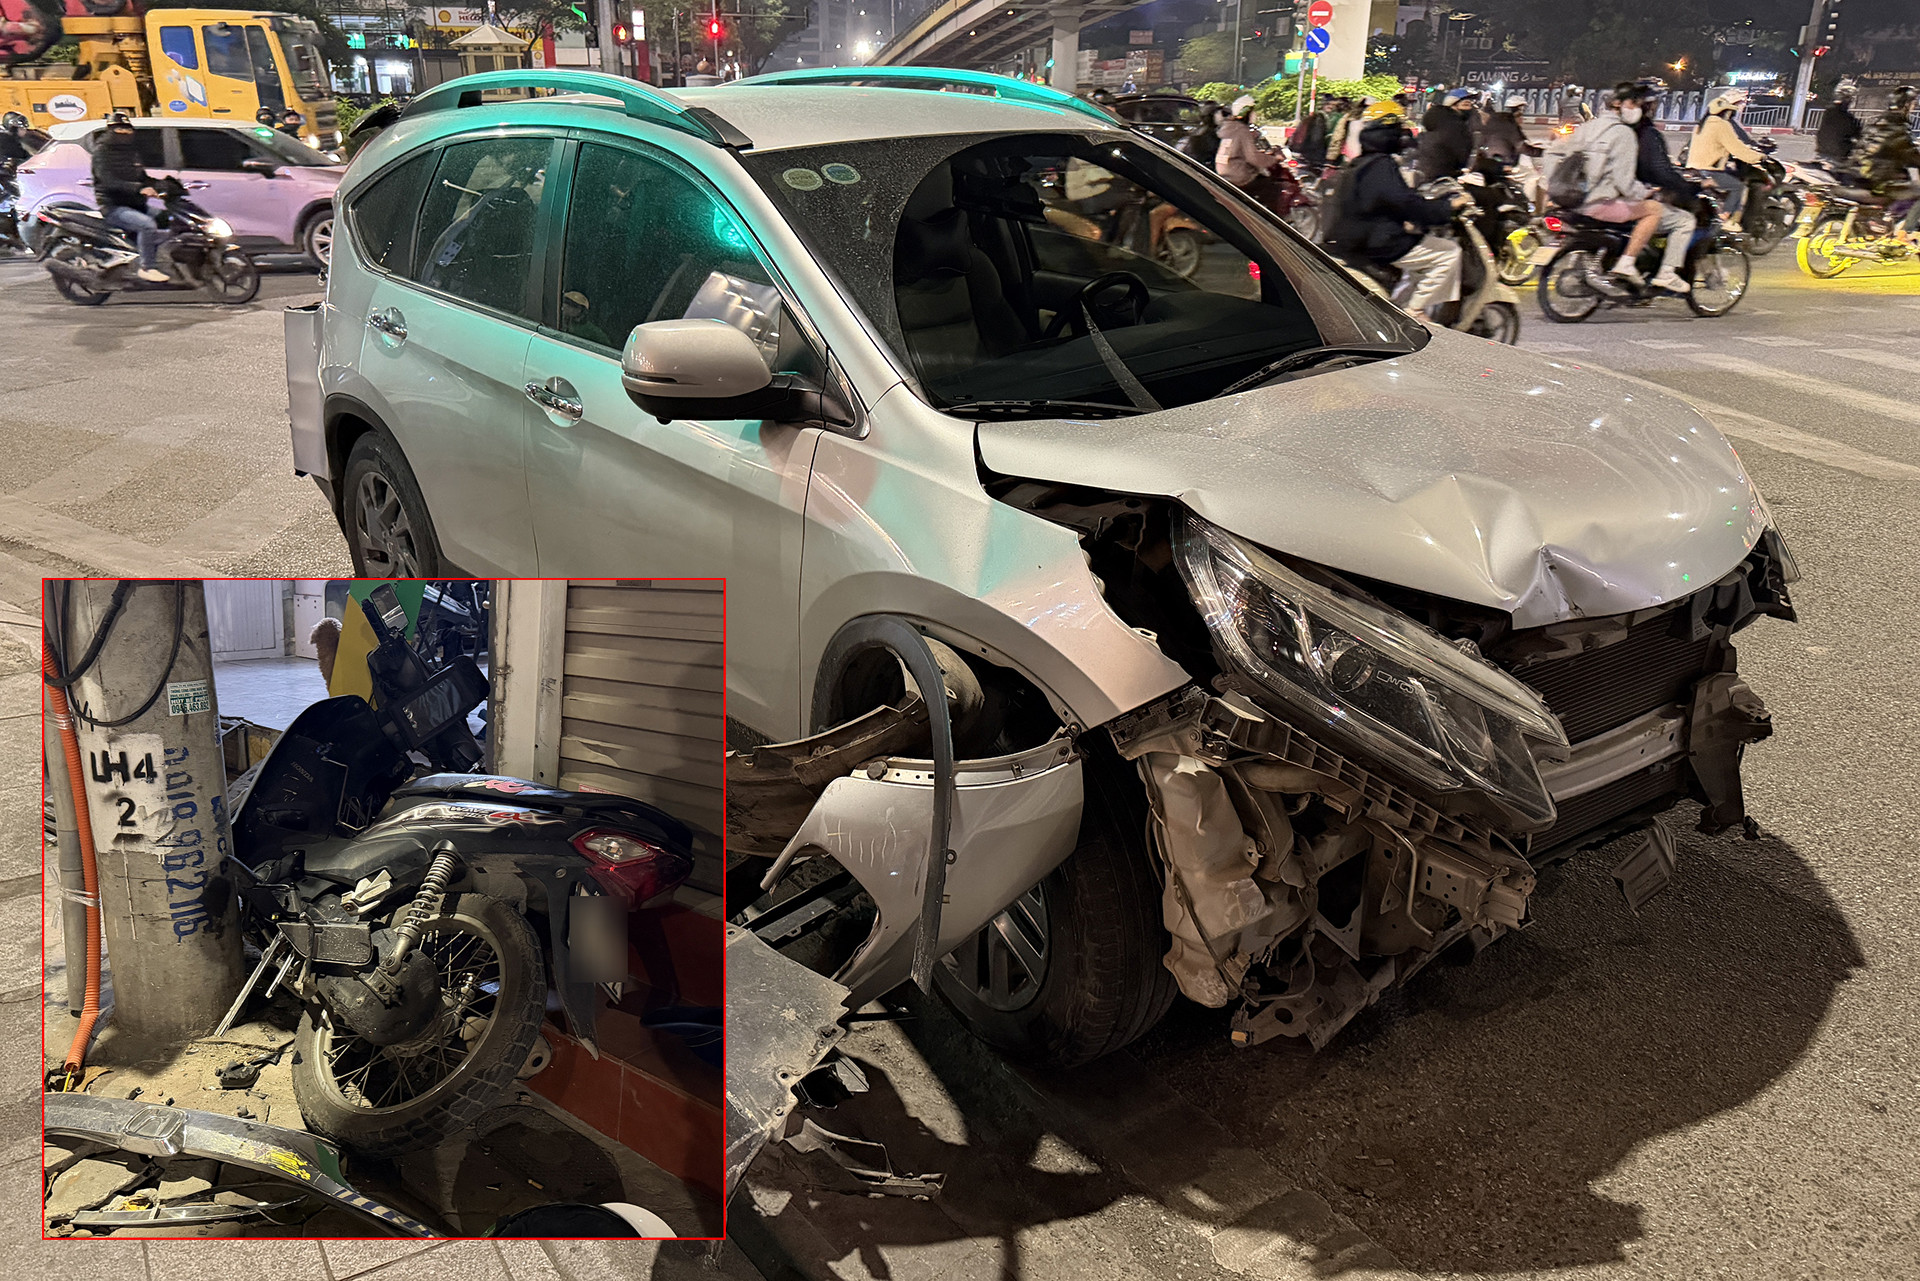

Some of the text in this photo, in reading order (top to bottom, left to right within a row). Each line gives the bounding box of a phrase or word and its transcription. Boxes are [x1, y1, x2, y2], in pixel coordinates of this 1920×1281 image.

[1466, 71, 1519, 82] GAMING
[290, 761, 314, 783] HONDA
[116, 797, 137, 827] 2
